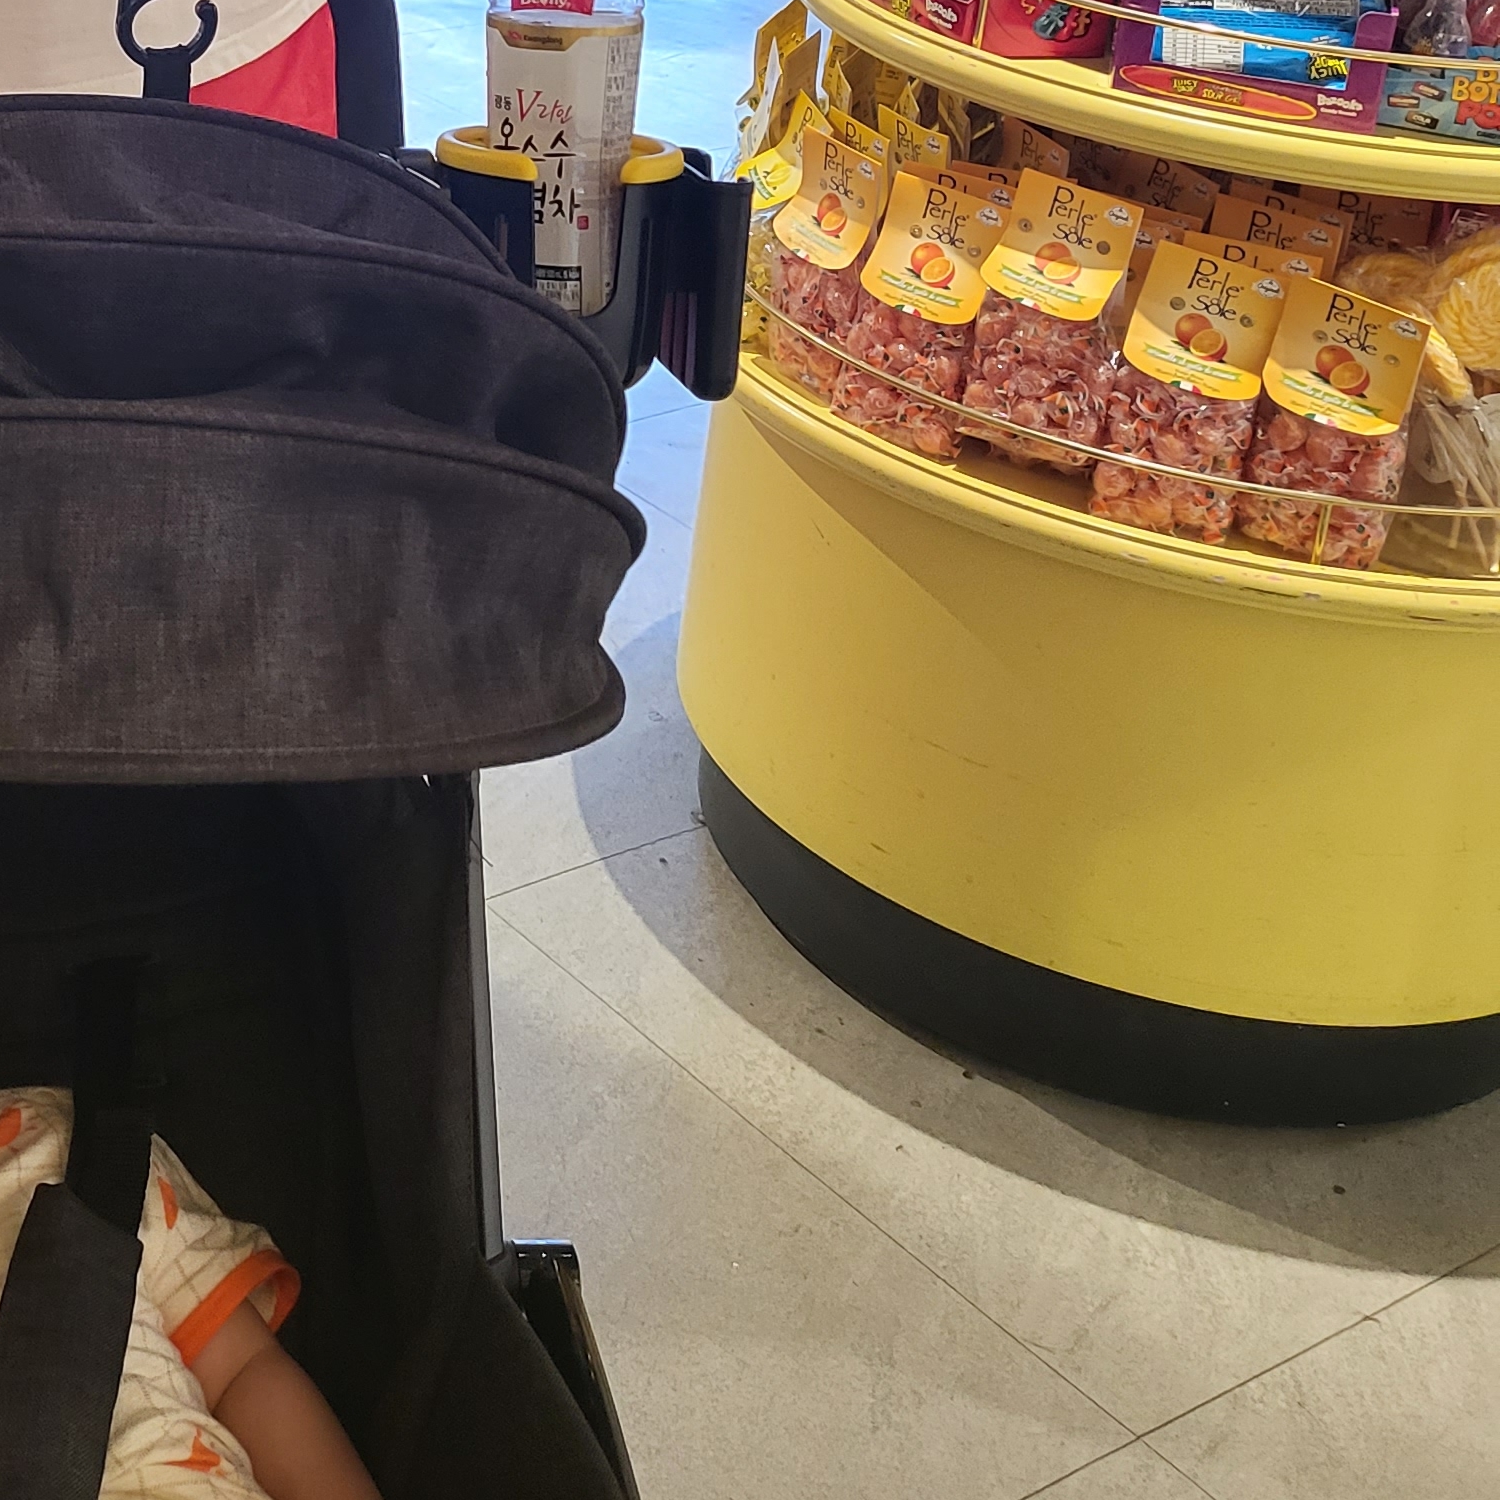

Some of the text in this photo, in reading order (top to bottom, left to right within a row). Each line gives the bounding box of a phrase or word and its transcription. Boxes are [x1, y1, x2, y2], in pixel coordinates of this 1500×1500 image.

[824, 141, 855, 181] Perle
[922, 188, 968, 228] Perle
[1048, 185, 1096, 227] Perle
[1187, 257, 1241, 298] Perle
[1325, 293, 1379, 336] Perle
